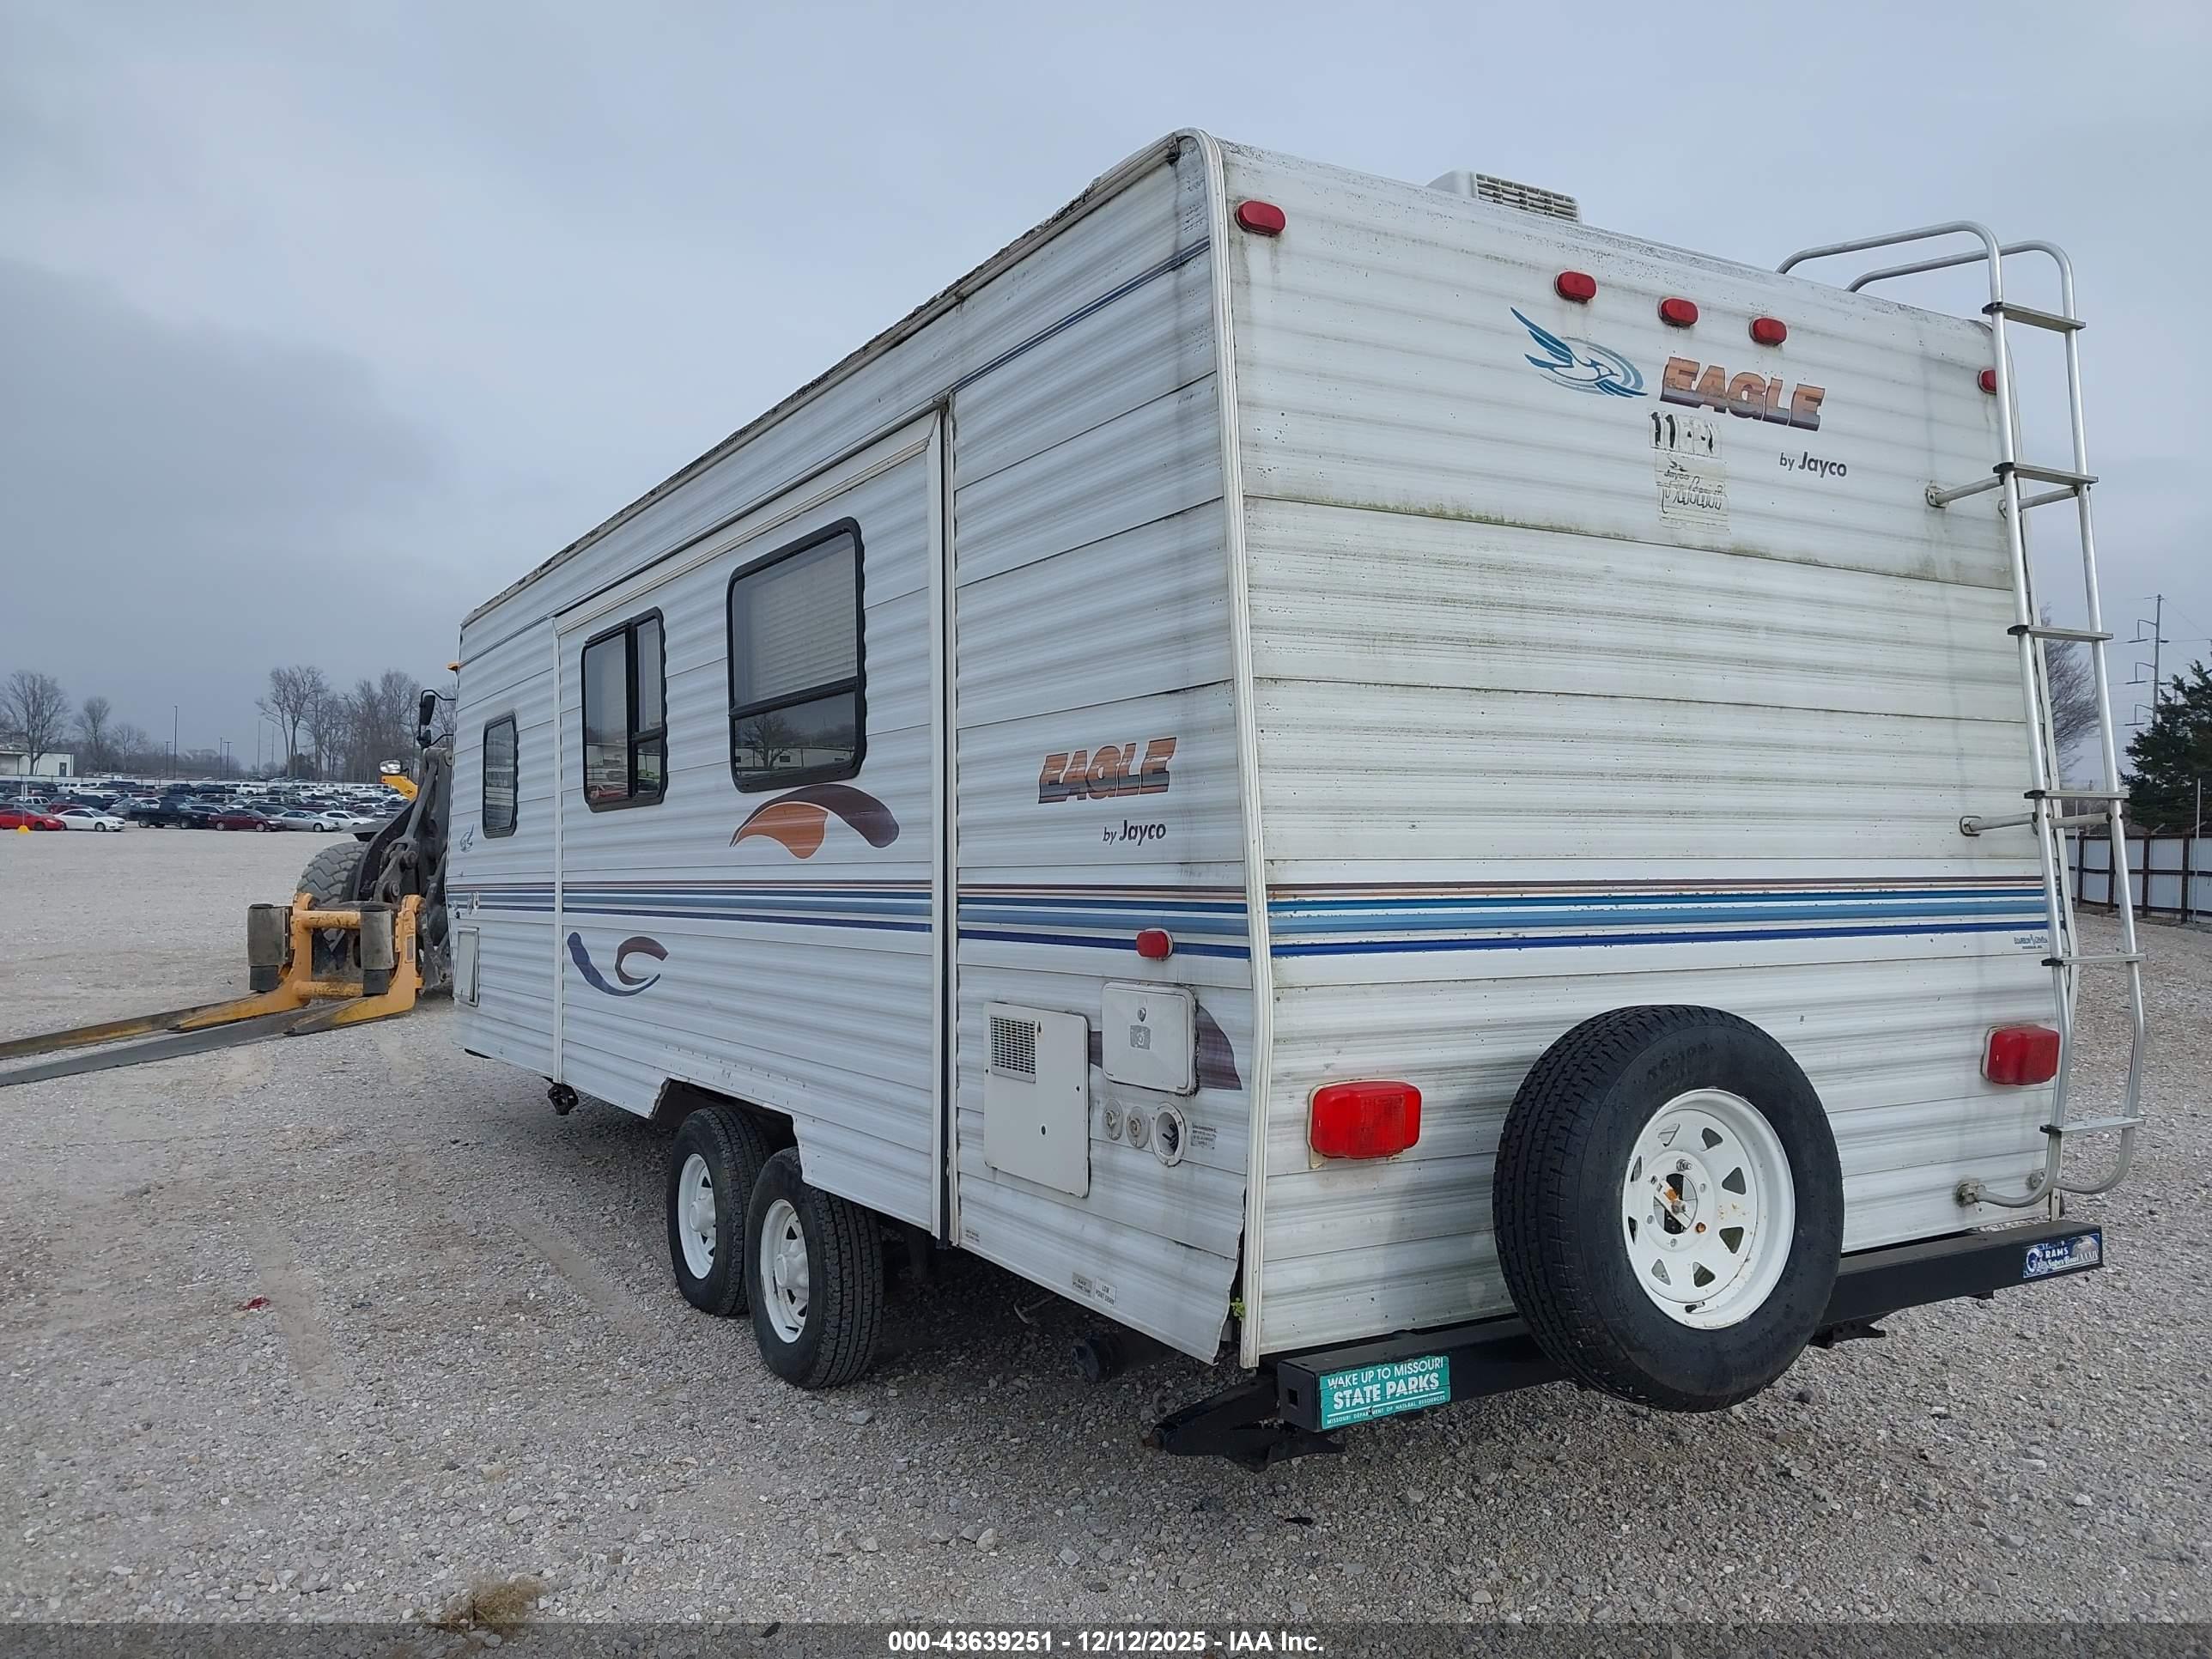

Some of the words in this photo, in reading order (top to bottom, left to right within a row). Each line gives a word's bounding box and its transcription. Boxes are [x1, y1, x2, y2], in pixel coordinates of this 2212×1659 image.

[1659, 356, 1826, 432] EAGLE
[1779, 453, 1796, 471] by
[1798, 451, 1847, 478] Jayco
[1038, 737, 1176, 805] EAGLE
[1103, 826, 1117, 845] by
[1119, 820, 1167, 847] Jayco
[2045, 1246, 2069, 1259] RAMS
[1328, 1373, 1358, 1389] WAKE
[1361, 1370, 1375, 1382] UP
[1377, 1367, 1391, 1381] TO
[1394, 1356, 1443, 1377] MISSOURI
[1333, 1383, 1381, 1410] STATE
[1386, 1372, 1440, 1400] PARKS
[1327, 1414, 1352, 1425] MISSOURI
[1395, 1401, 1416, 1412] NATURAL
[1419, 1395, 1446, 1406] RESOURCES
